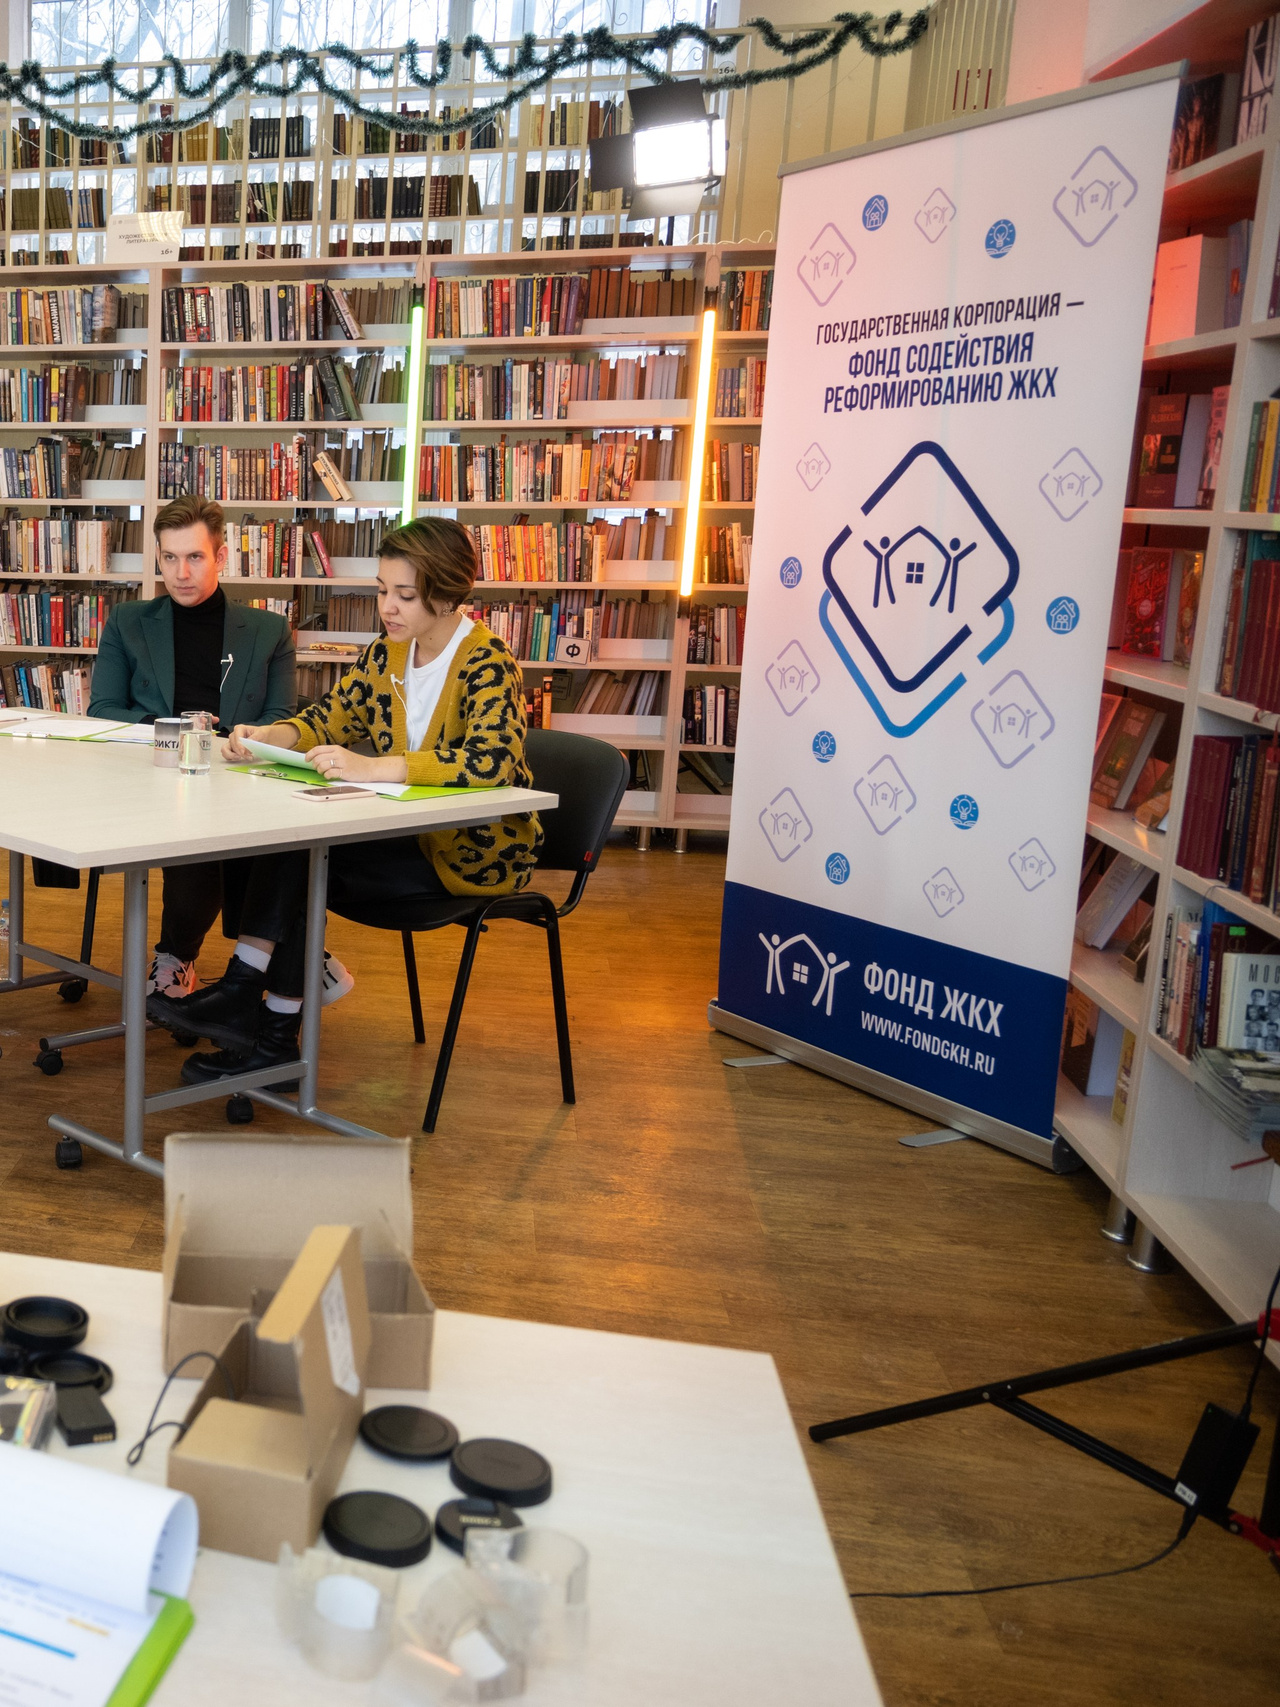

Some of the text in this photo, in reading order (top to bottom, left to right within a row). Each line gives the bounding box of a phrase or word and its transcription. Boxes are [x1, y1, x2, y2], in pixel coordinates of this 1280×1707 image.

[50, 303, 61, 342] МАКАНИН
[816, 307, 950, 345] ГОСУДАРСТВЕННАЯ
[953, 292, 1061, 329] КОРПОРАЦИЯ
[848, 331, 1034, 379] ФОНД СОДЕЙСТВИЯ
[823, 366, 1059, 414] РЕФОРМИРОВАНИЮ ЖКХ
[565, 643, 581, 658] Ф
[863, 961, 1004, 1038] ФОНД ЖКХ
[861, 1010, 995, 1076] WWW.FONDGKH.RU
